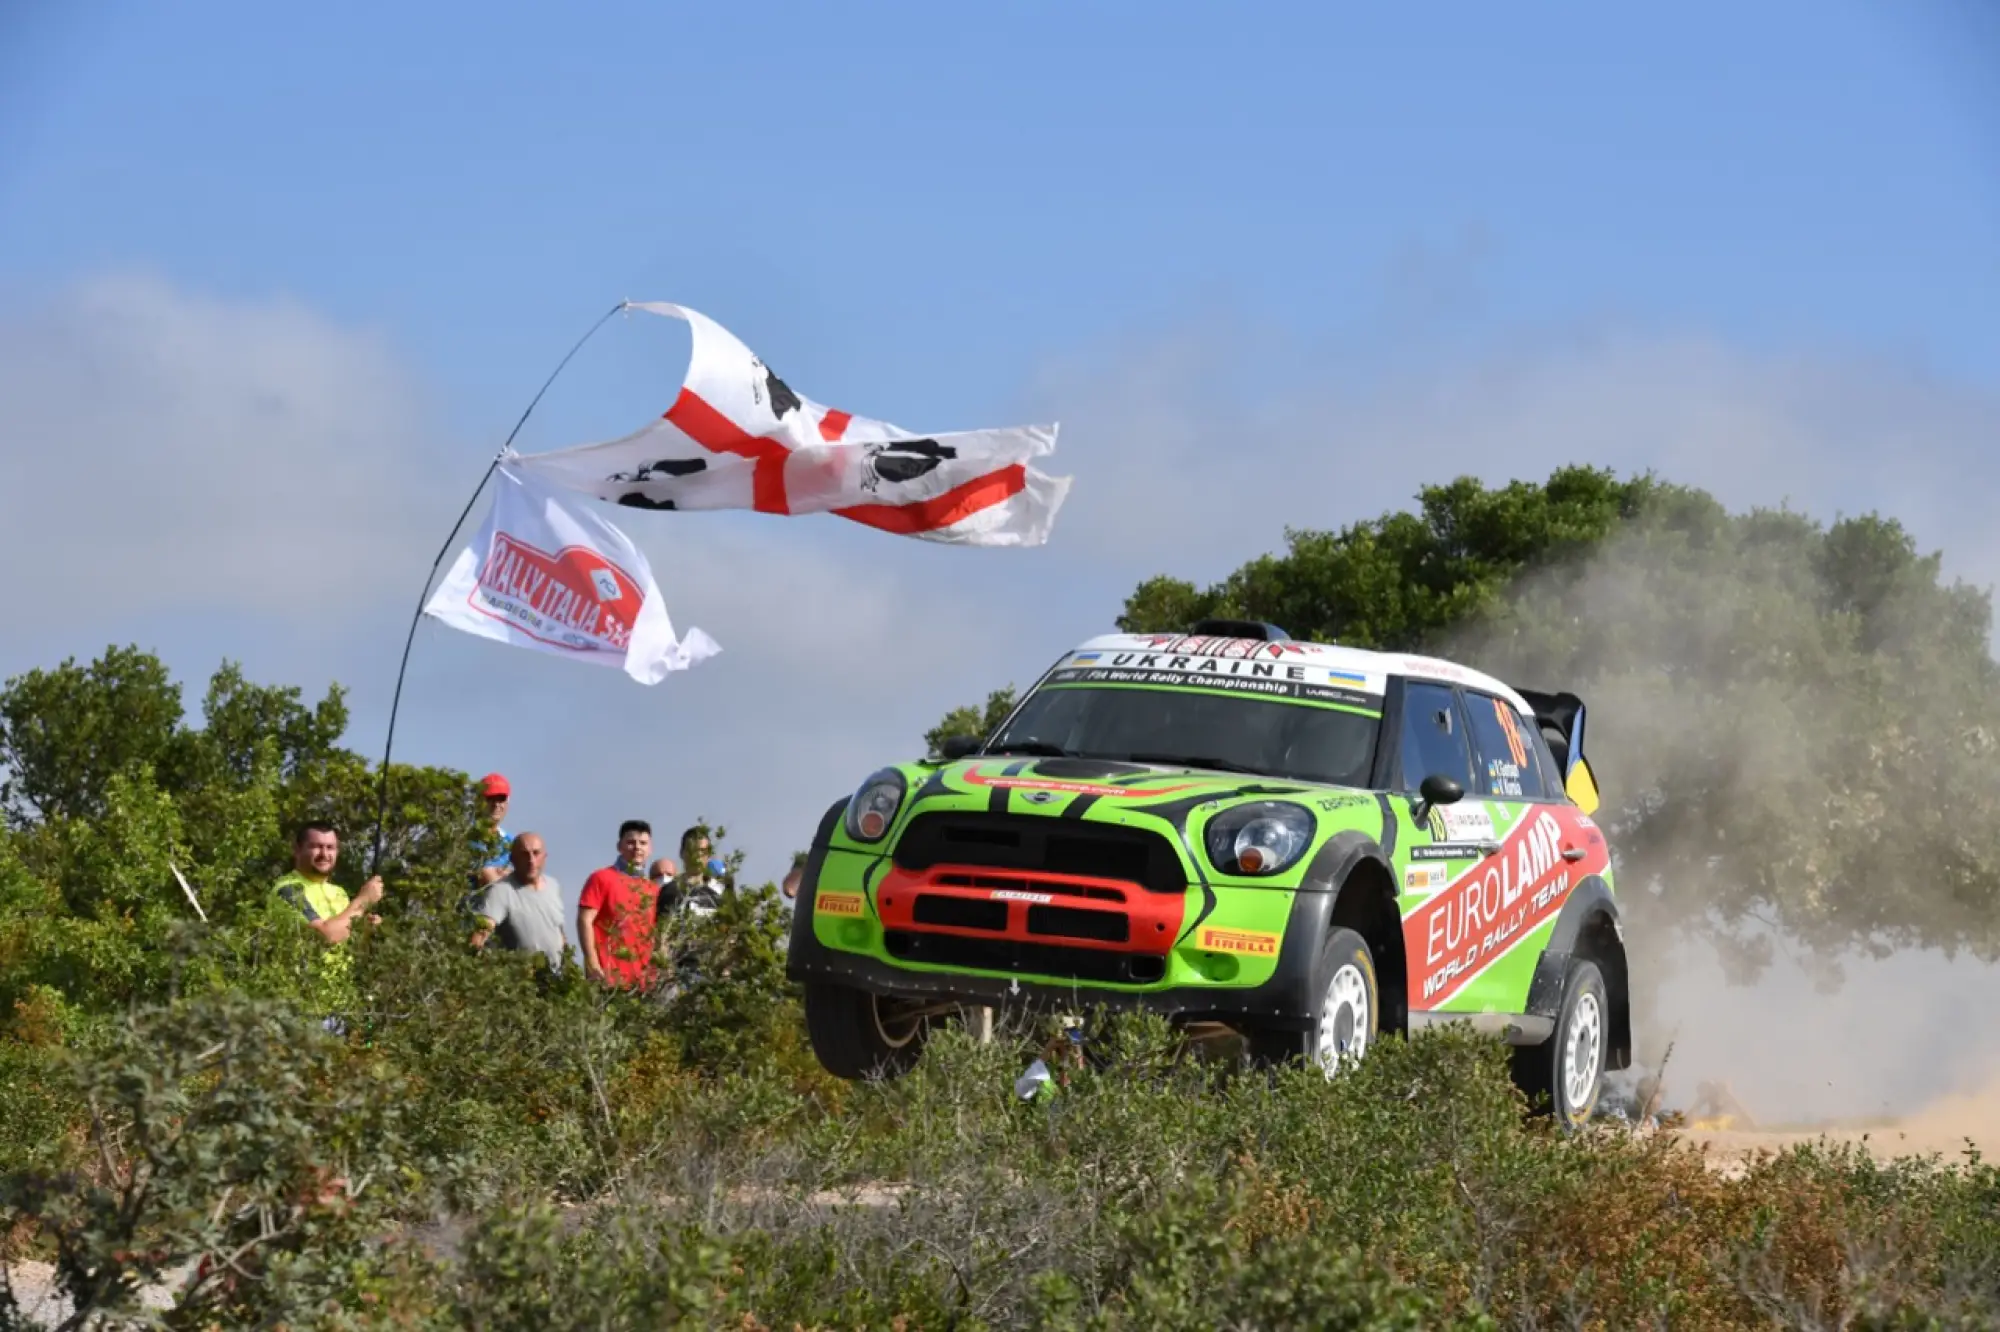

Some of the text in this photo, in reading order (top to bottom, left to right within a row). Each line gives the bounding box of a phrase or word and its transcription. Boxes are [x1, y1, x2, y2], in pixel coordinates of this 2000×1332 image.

[484, 539, 600, 636] RALLY ITALIA
[1111, 653, 1305, 680] UKRAINE
[1109, 670, 1149, 682] World
[1149, 672, 1184, 685] Rally
[1187, 675, 1288, 694] Championship
[1426, 810, 1561, 966] EUROLAMP
[817, 894, 861, 913] PIRELLI
[1205, 930, 1275, 953] PIRELLI
[1423, 871, 1568, 999] WORLD RALLY TEAM
